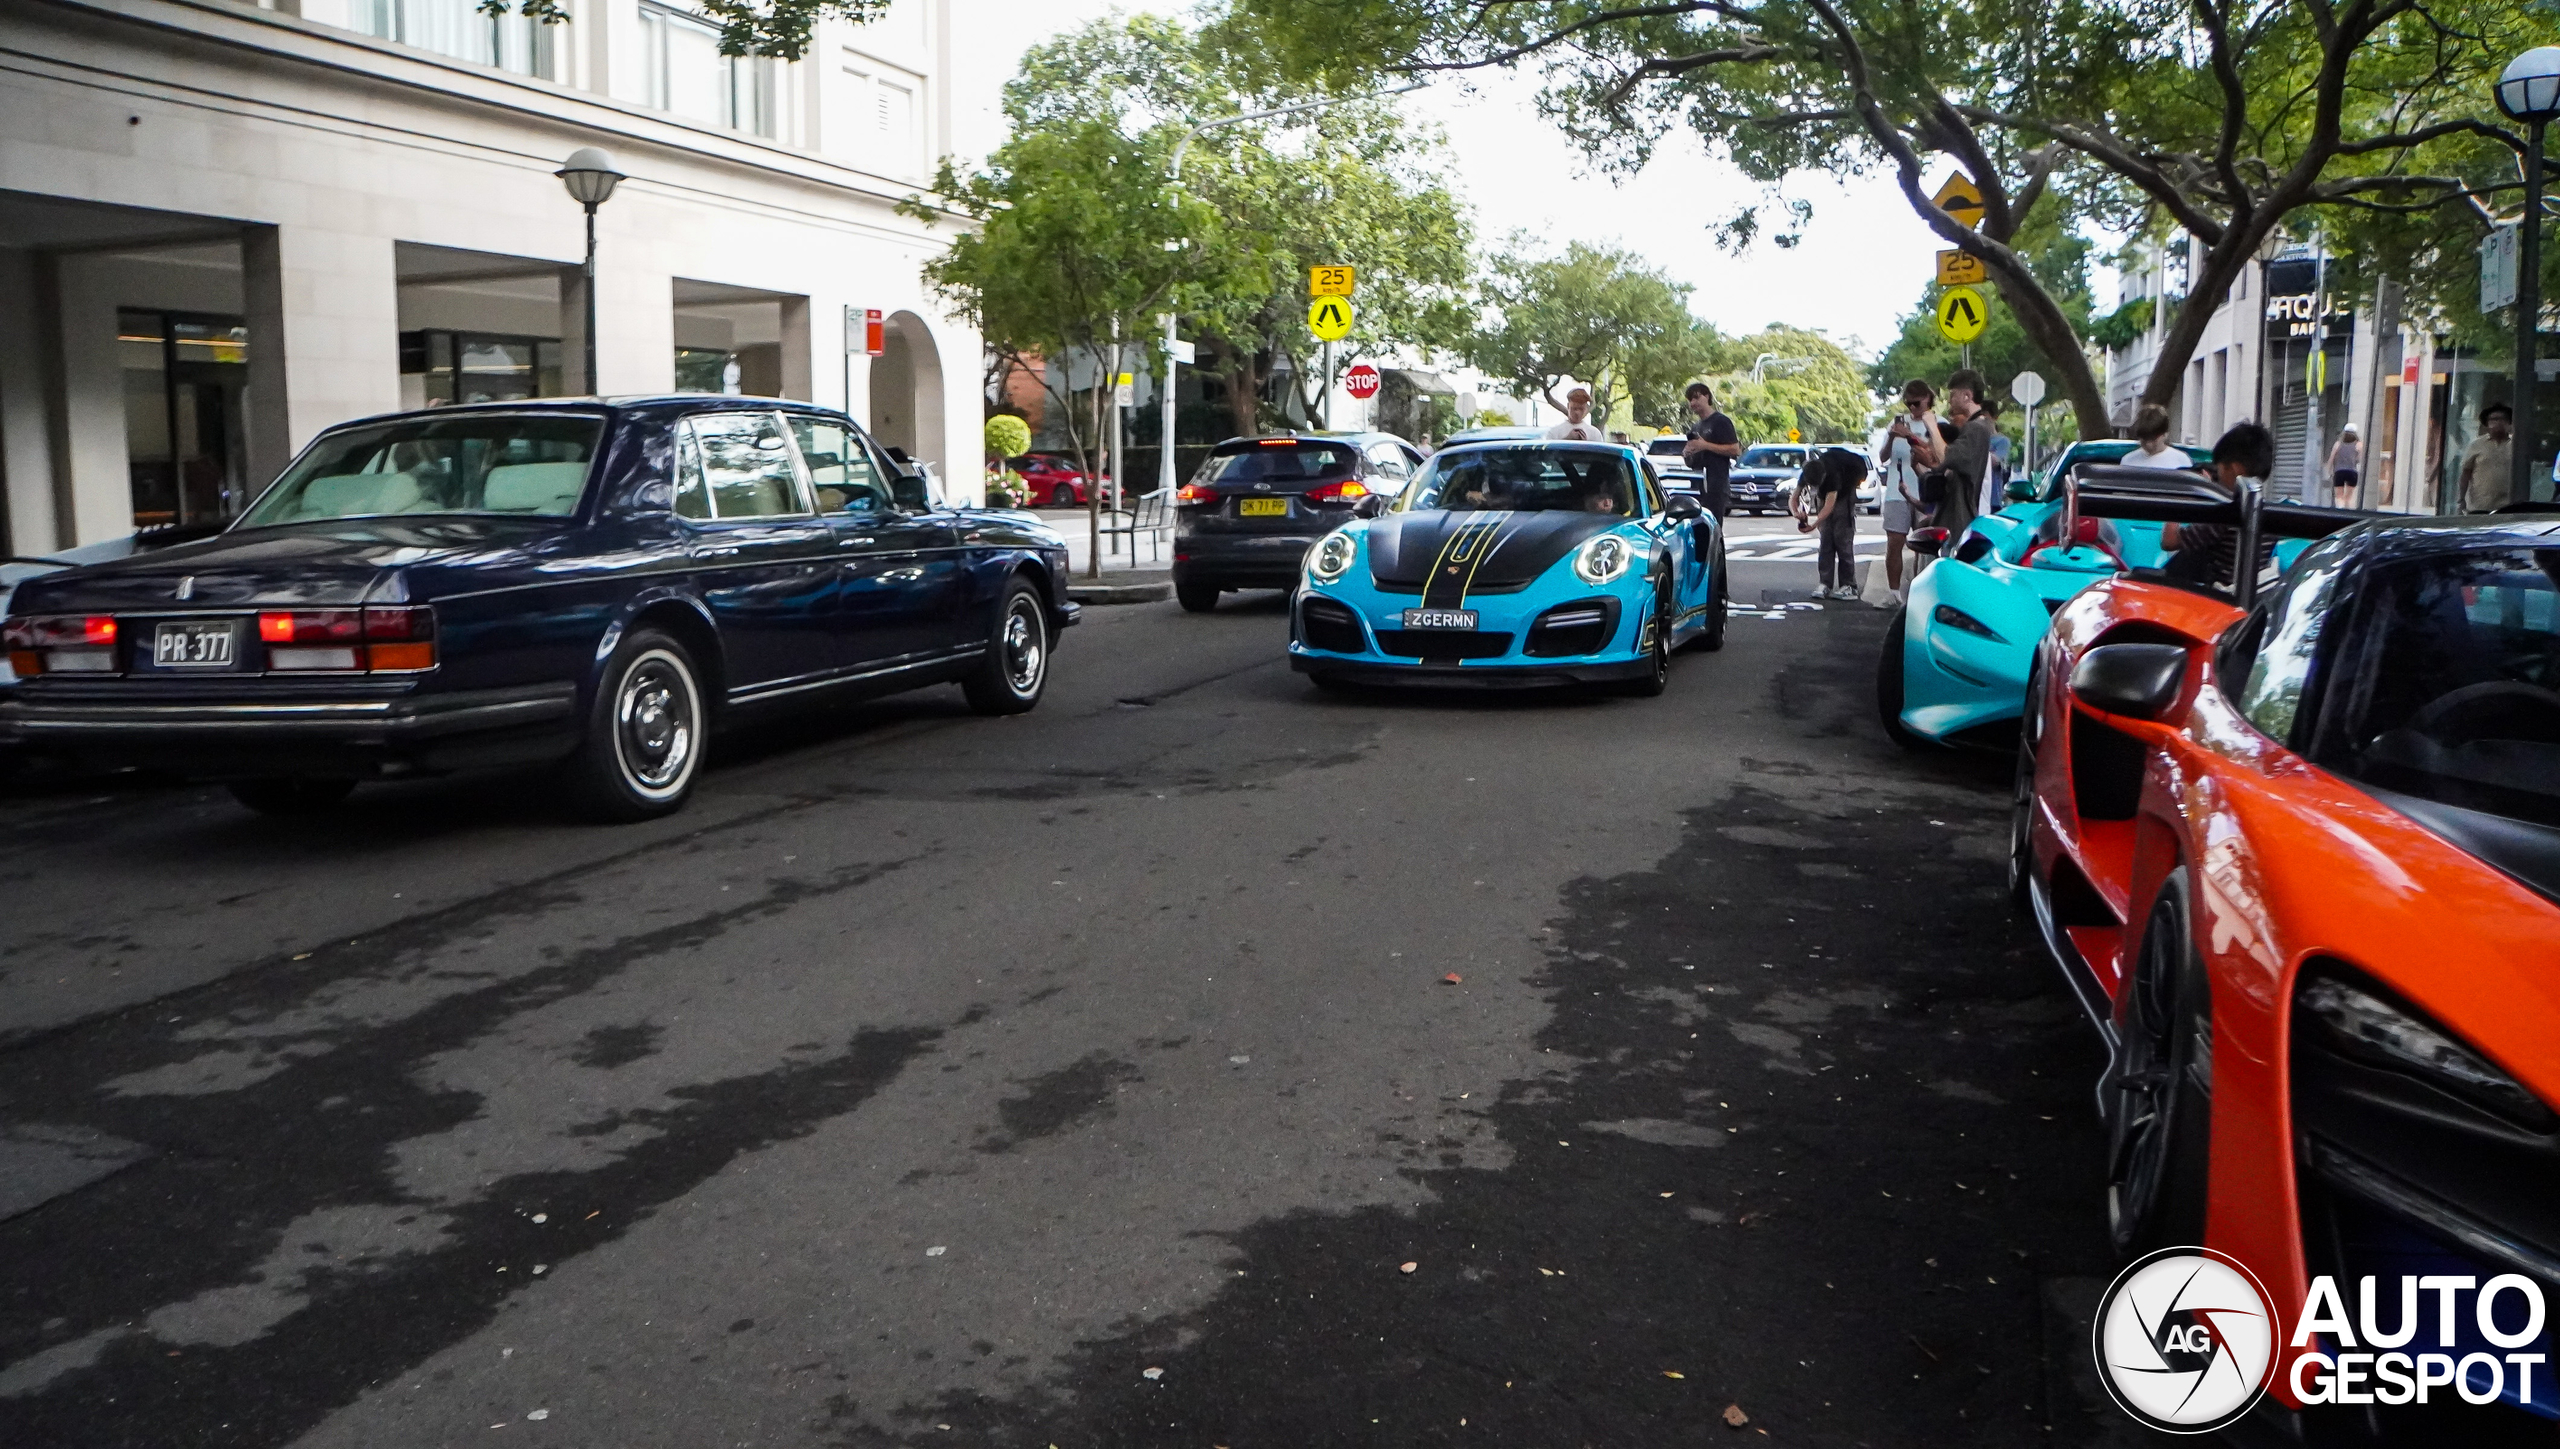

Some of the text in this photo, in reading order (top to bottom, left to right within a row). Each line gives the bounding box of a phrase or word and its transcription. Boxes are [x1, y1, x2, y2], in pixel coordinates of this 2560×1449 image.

[1320, 269, 1344, 285] 25
[1346, 374, 1378, 390] STOP
[1412, 613, 1474, 627] ZGERMN
